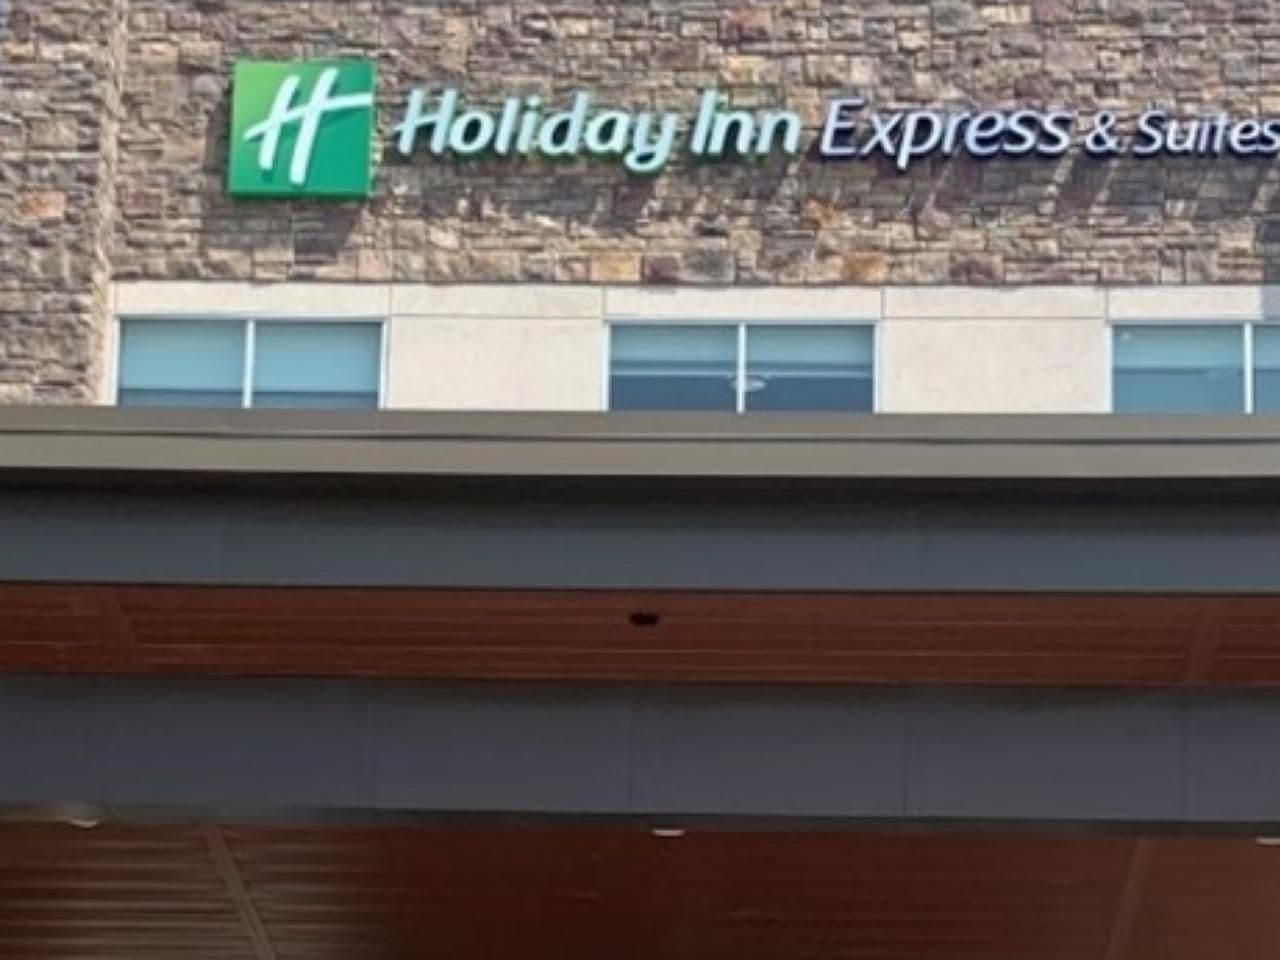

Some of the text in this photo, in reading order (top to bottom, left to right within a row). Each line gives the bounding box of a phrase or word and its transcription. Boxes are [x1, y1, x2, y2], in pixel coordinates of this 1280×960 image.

[394, 88, 677, 173] Holiday
[690, 88, 801, 154] Inn
[820, 96, 1072, 170] Express
[1085, 110, 1118, 154] &
